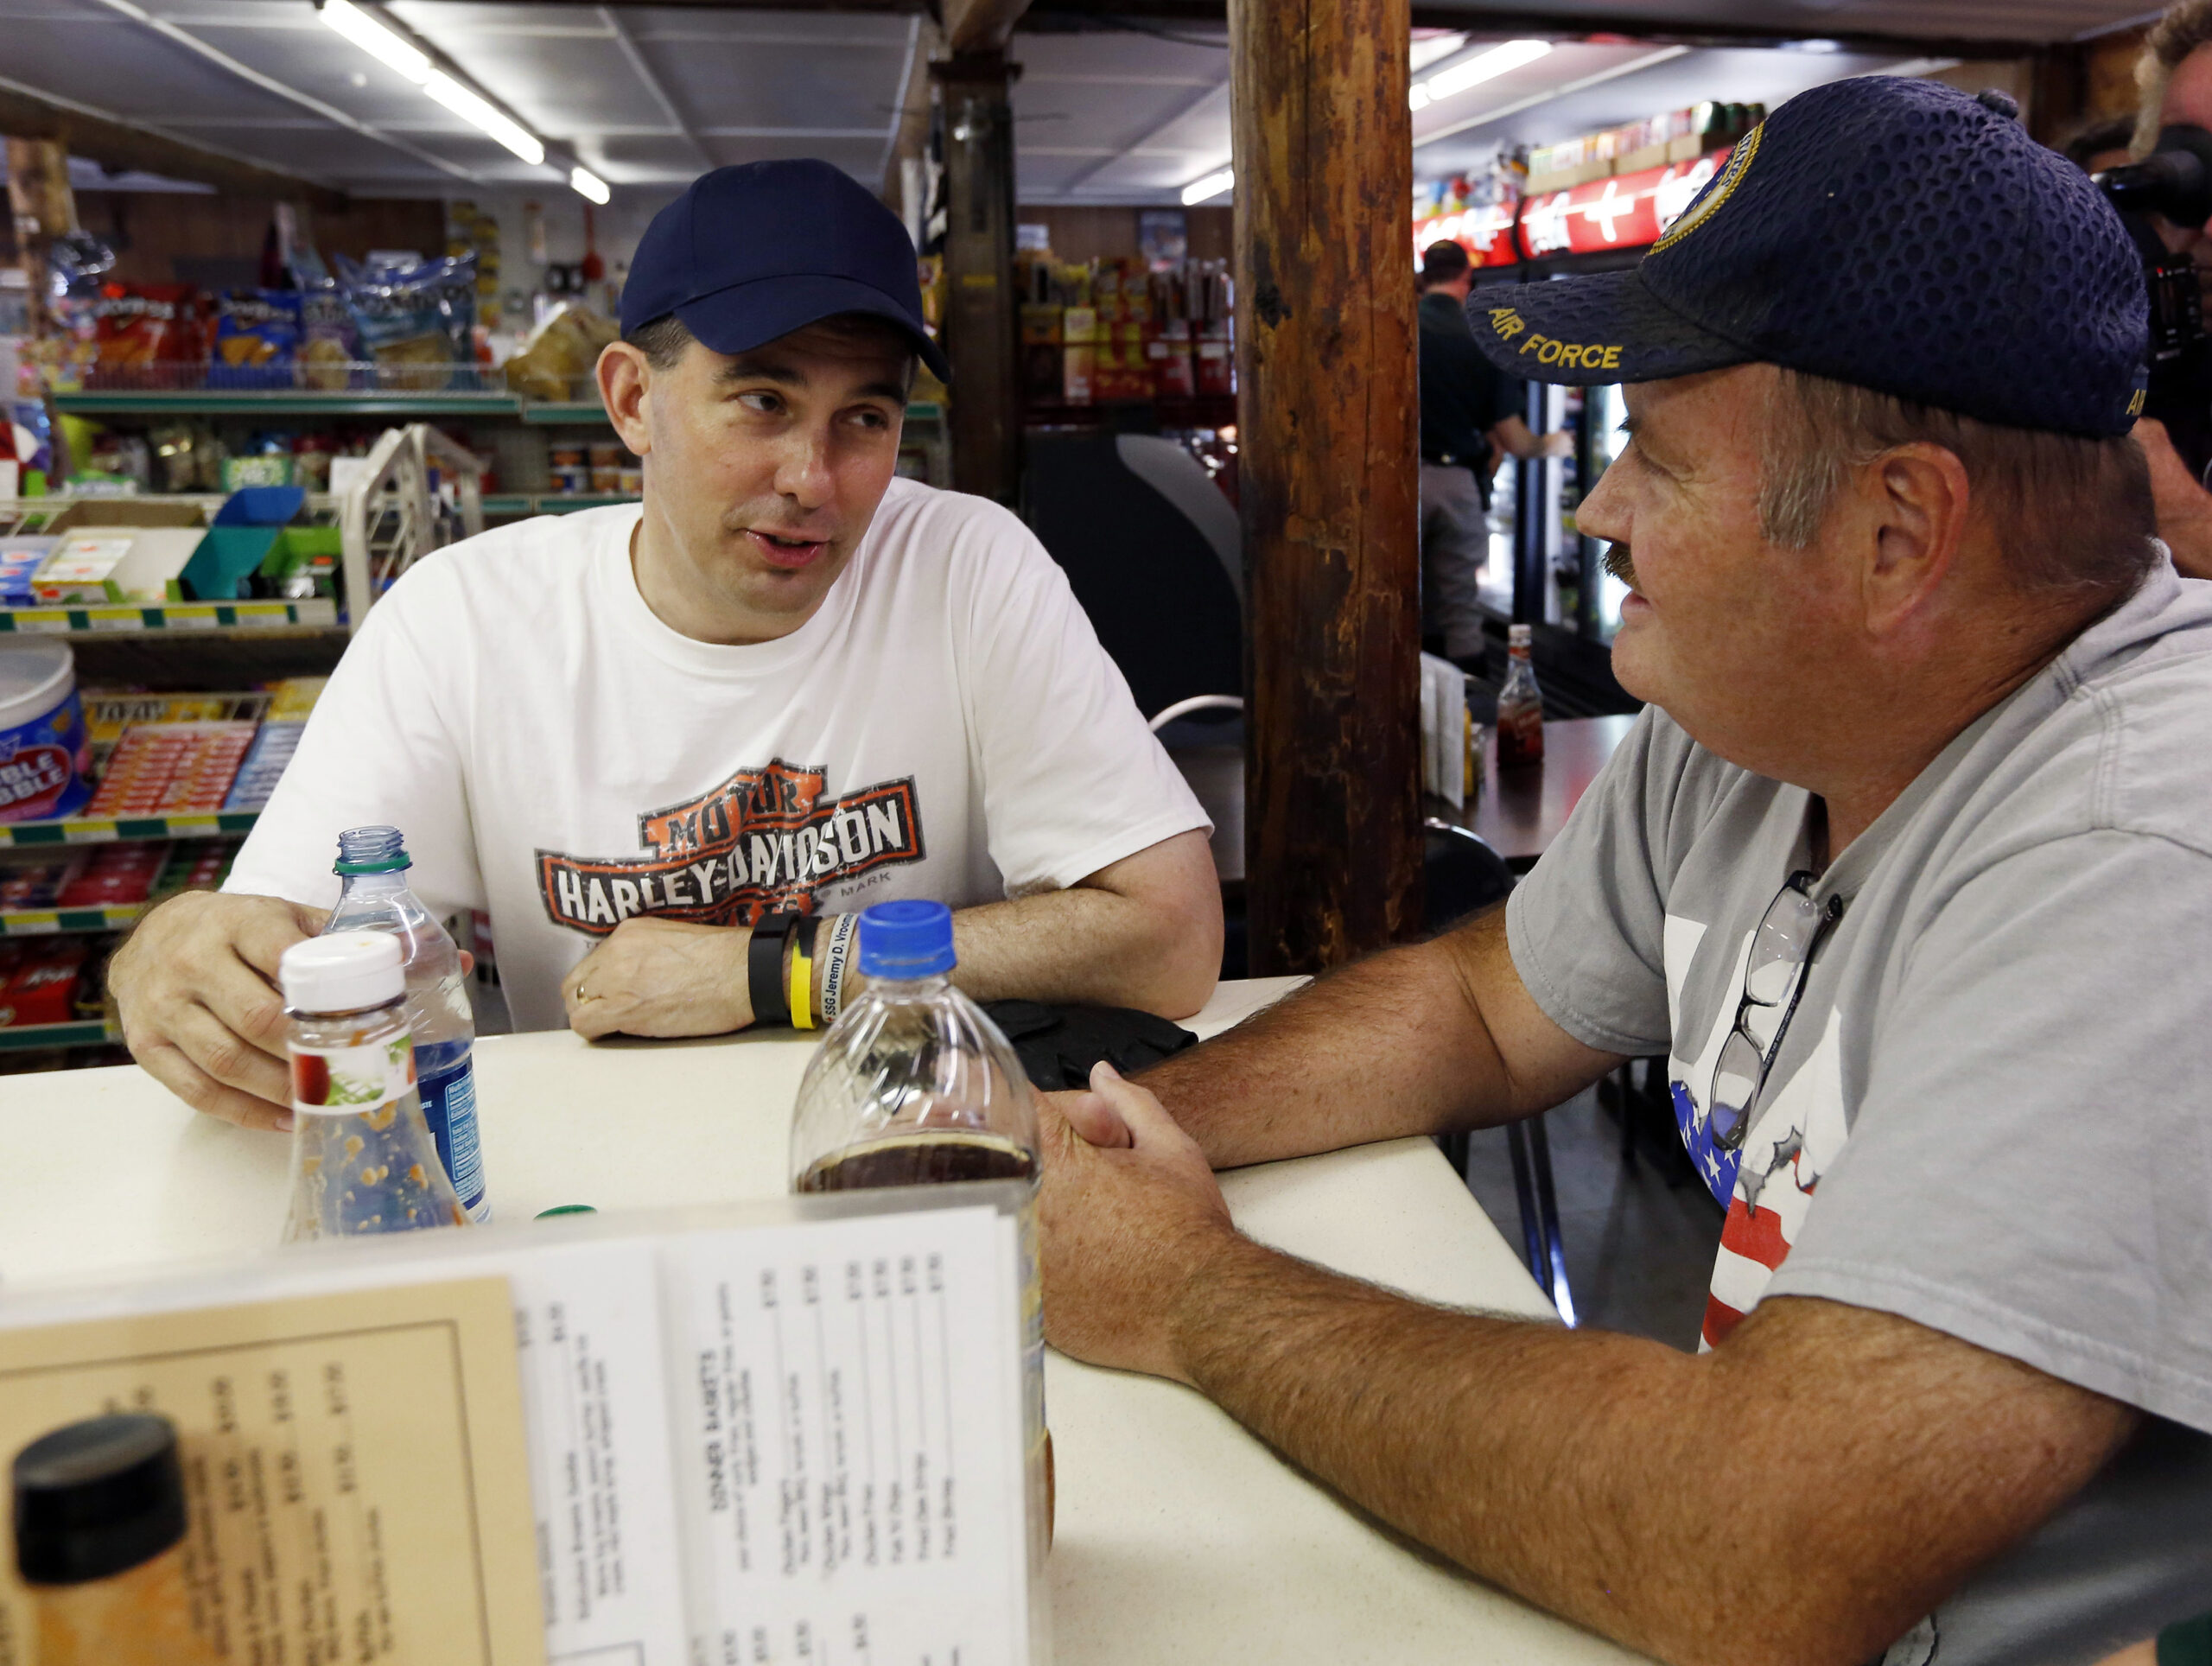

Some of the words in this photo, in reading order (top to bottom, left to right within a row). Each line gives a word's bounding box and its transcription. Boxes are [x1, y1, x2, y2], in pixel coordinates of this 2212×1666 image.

[1488, 308, 1525, 340] AIR
[1518, 334, 1624, 369] FORCE
[666, 773, 803, 853] MOTOR
[557, 799, 903, 924] HARLEY-DAVIDSON
[841, 872, 891, 897] MARK
[831, 943, 844, 955] D.
[825, 955, 844, 995] Jeremy
[824, 995, 836, 1016] SSG
